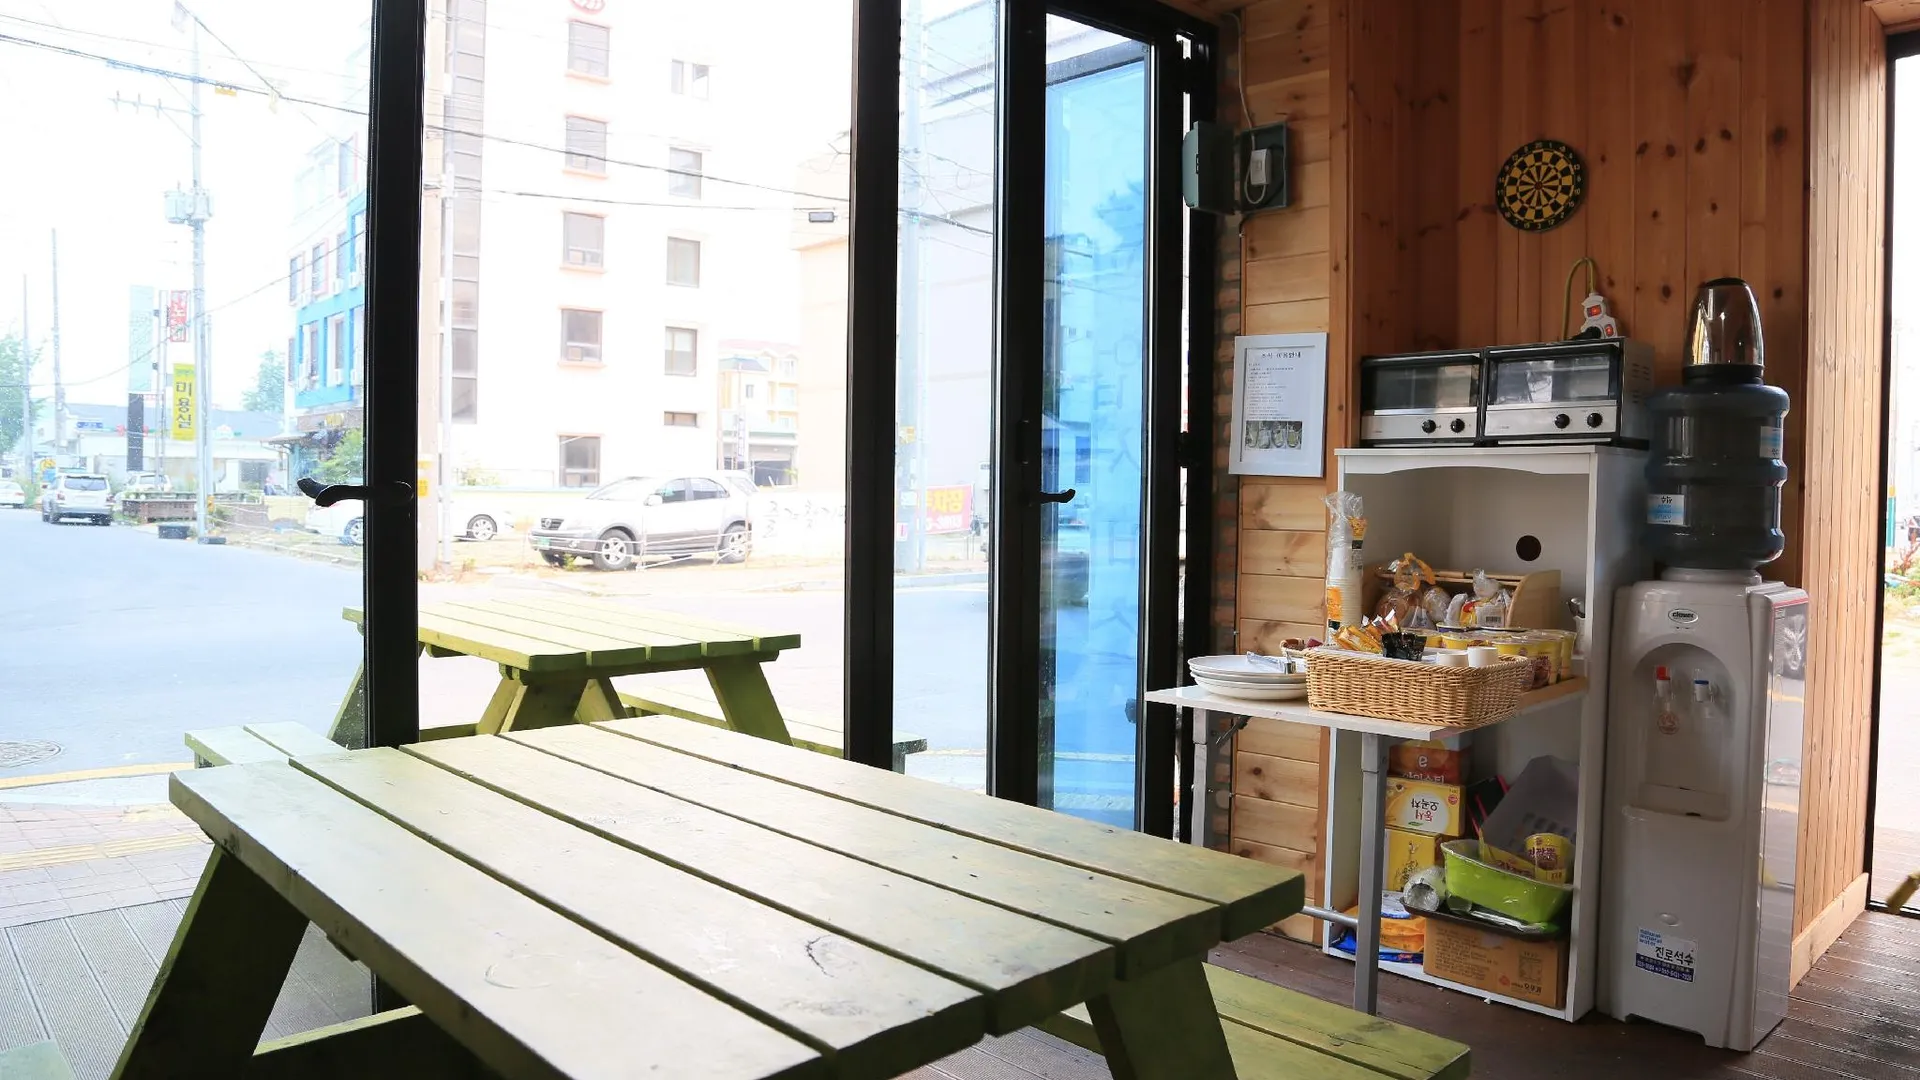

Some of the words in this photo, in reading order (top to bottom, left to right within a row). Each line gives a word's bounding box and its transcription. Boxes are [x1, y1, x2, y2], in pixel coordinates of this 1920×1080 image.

[176, 381, 192, 429] 미용실
[1411, 798, 1439, 811] 오곡차
[1415, 809, 1433, 822] 동서
[1655, 946, 1694, 966] 진로석수
